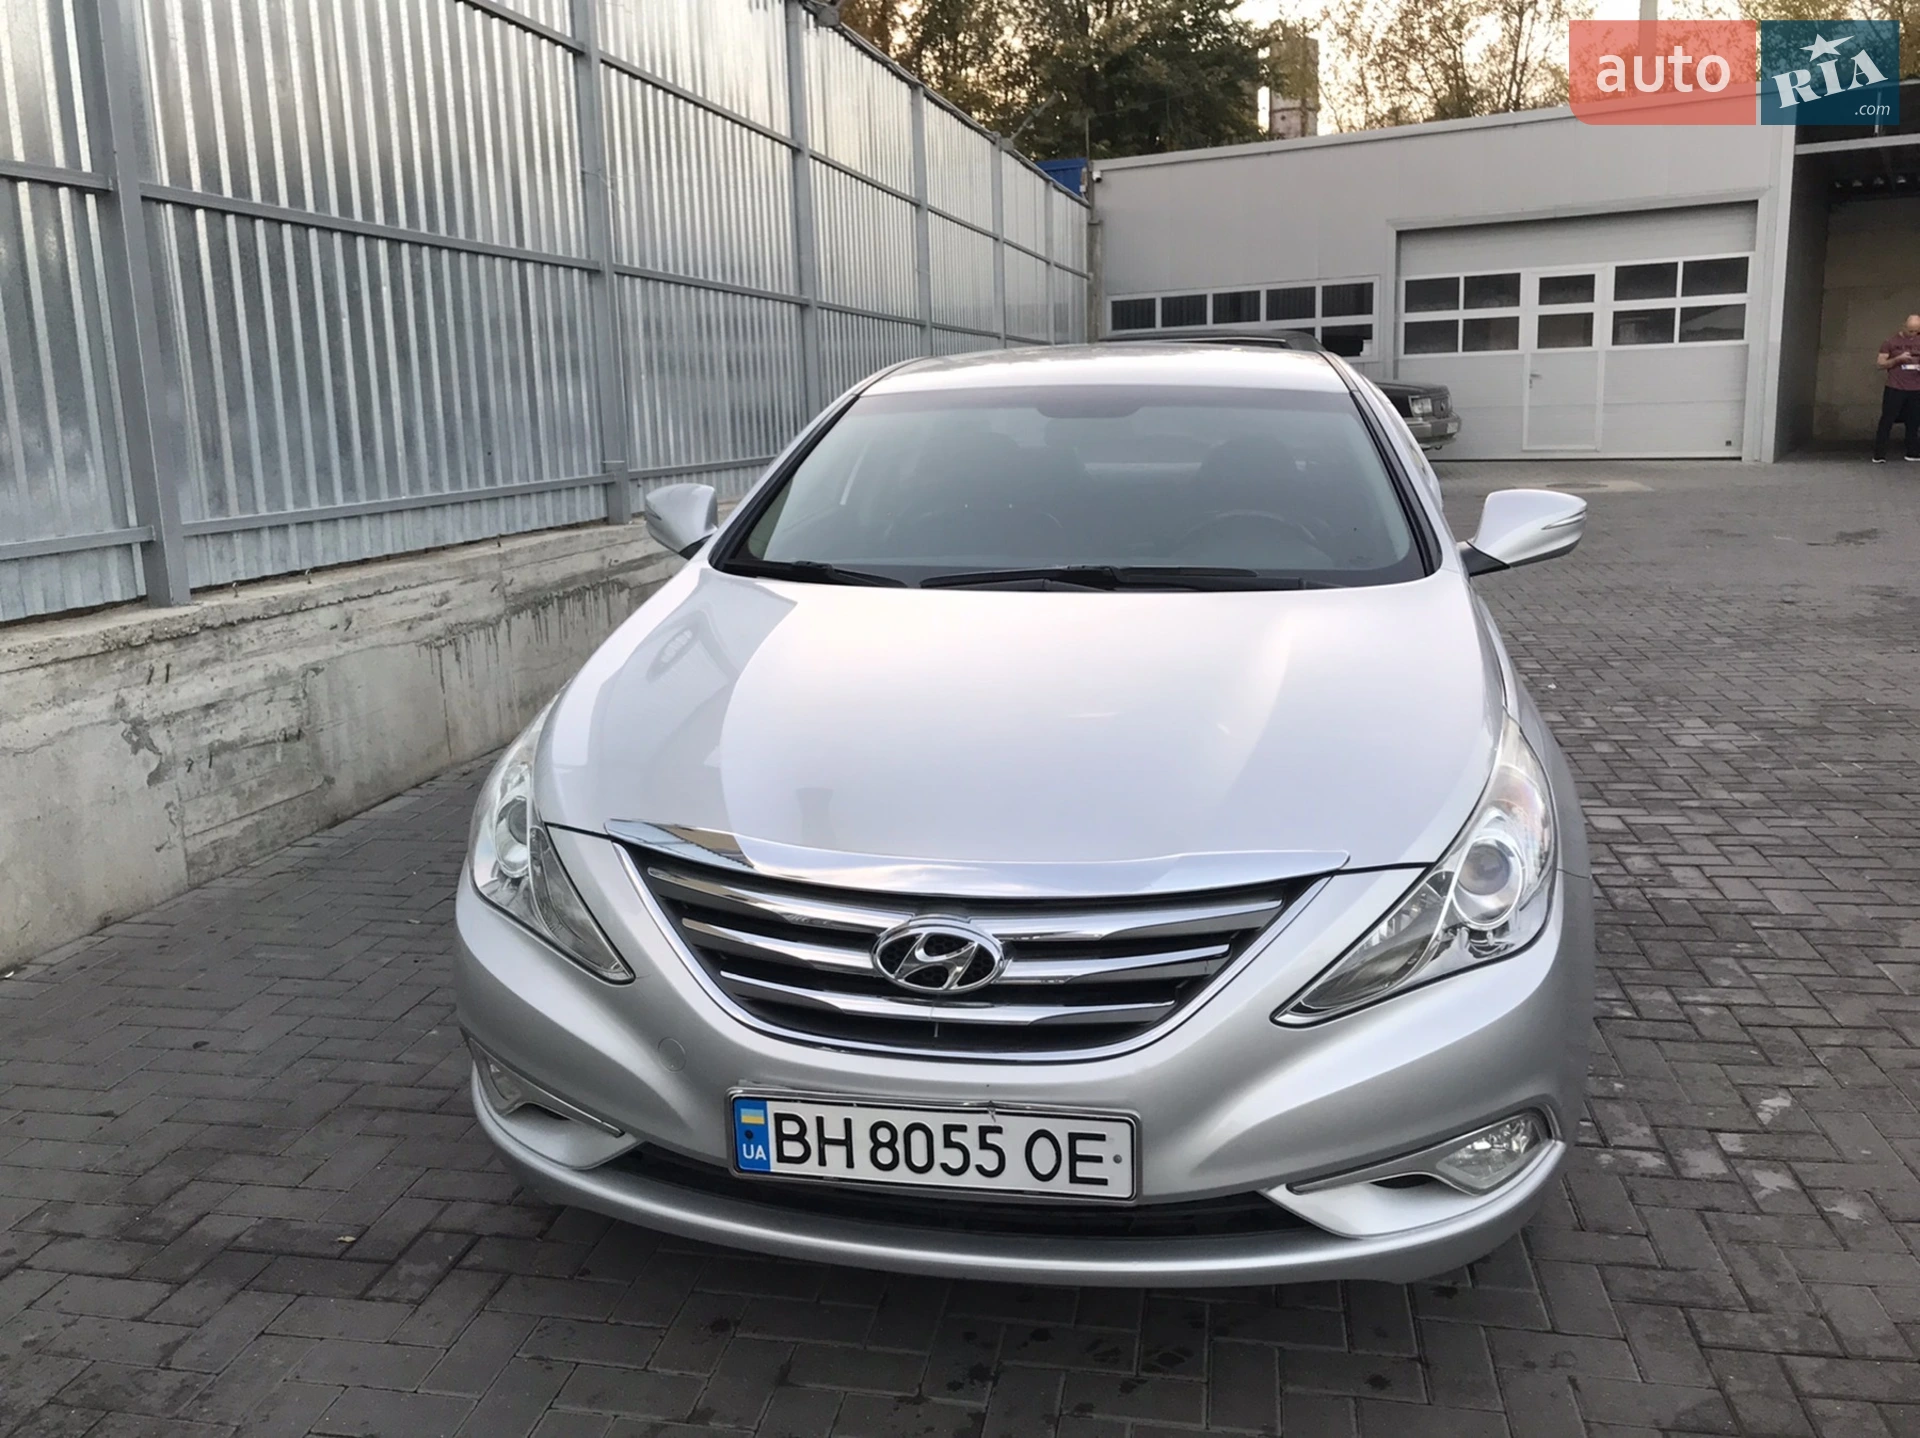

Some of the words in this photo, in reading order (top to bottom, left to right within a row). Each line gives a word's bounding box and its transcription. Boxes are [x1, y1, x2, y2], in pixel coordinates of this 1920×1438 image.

[742, 1143, 767, 1162] UA
[773, 1112, 855, 1169] BH
[869, 1119, 1006, 1178] 8055
[1024, 1128, 1109, 1186] OE
